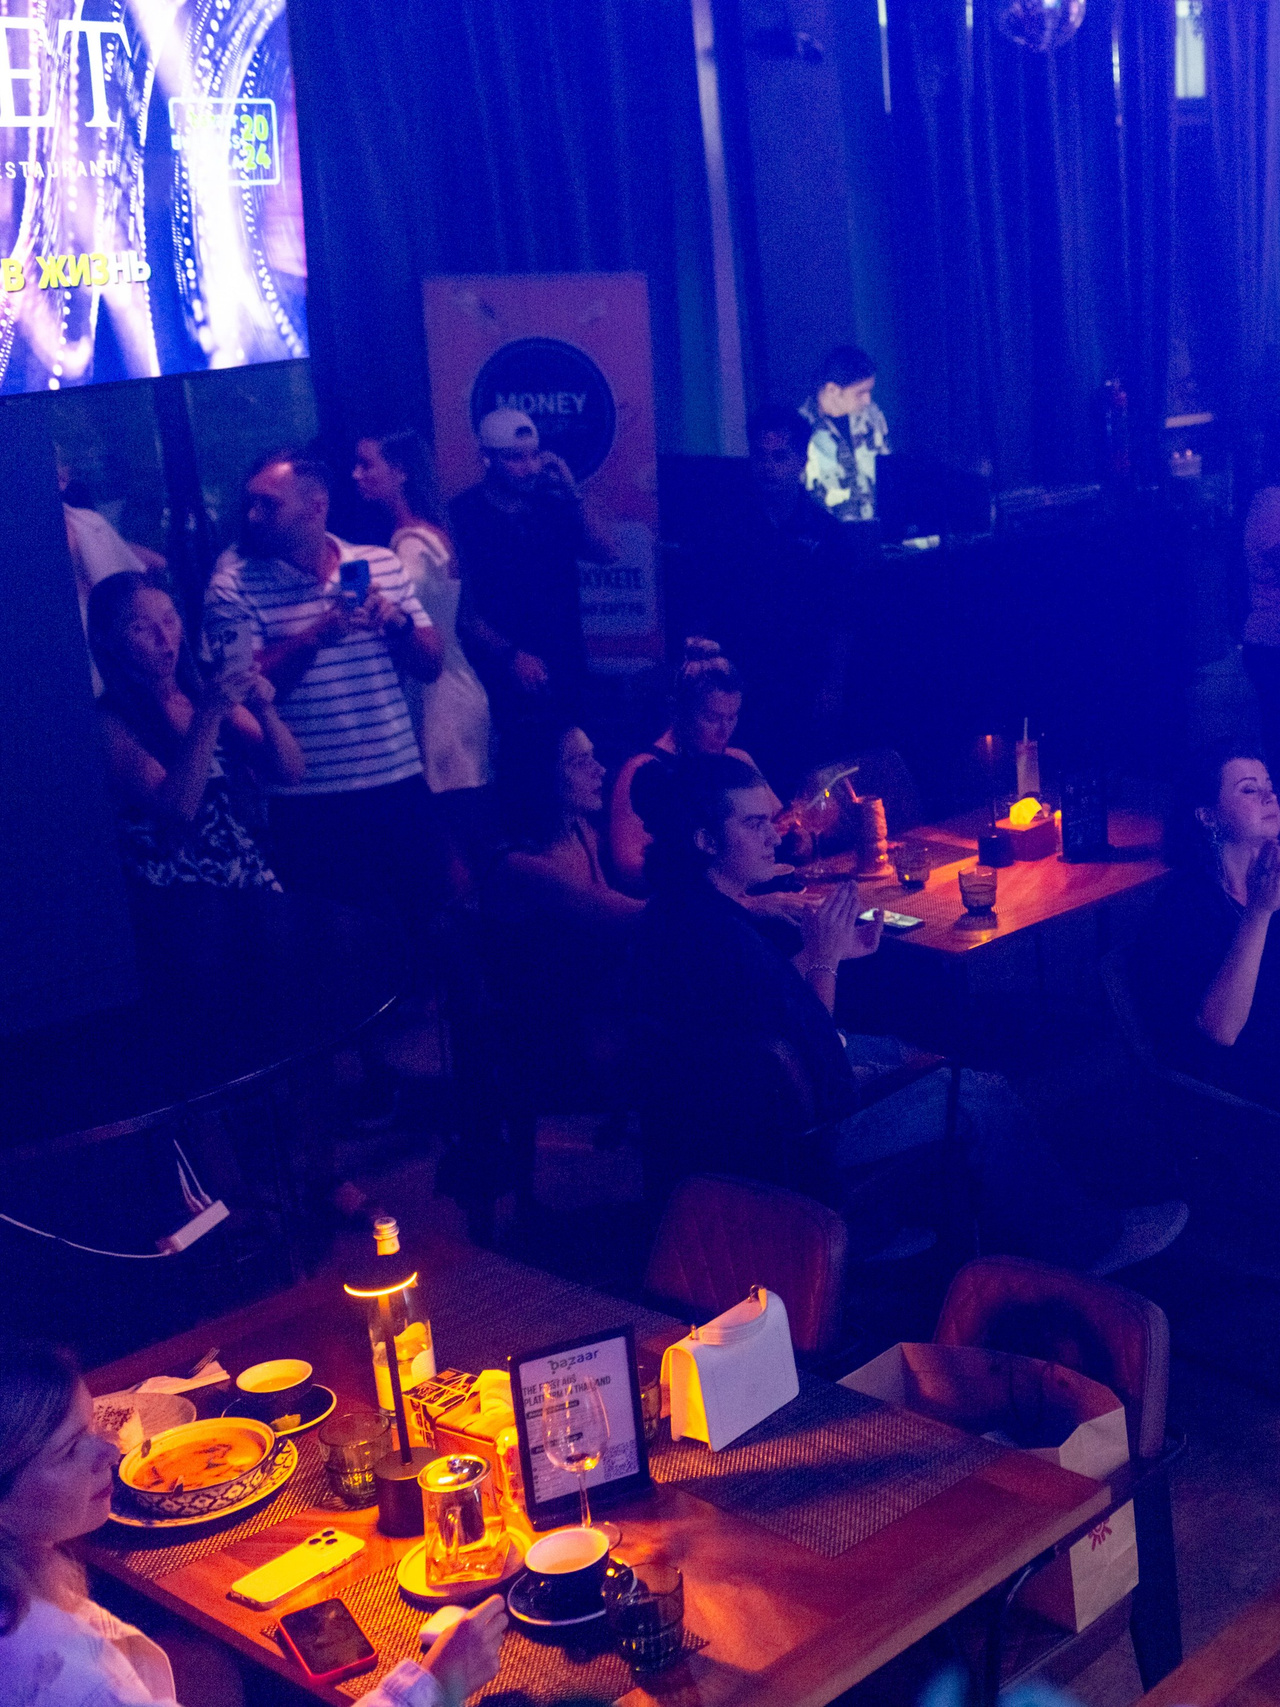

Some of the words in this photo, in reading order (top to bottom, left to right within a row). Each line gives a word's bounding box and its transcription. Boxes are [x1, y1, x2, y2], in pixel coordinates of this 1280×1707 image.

[240, 114, 269, 142] 20
[0, 160, 114, 179] STAURANT
[36, 250, 151, 289] ЖИЗНЬ
[494, 391, 587, 416] MONEY
[547, 1349, 600, 1374] bazaar
[523, 1384, 538, 1397] THE
[574, 1375, 611, 1392] THALAND
